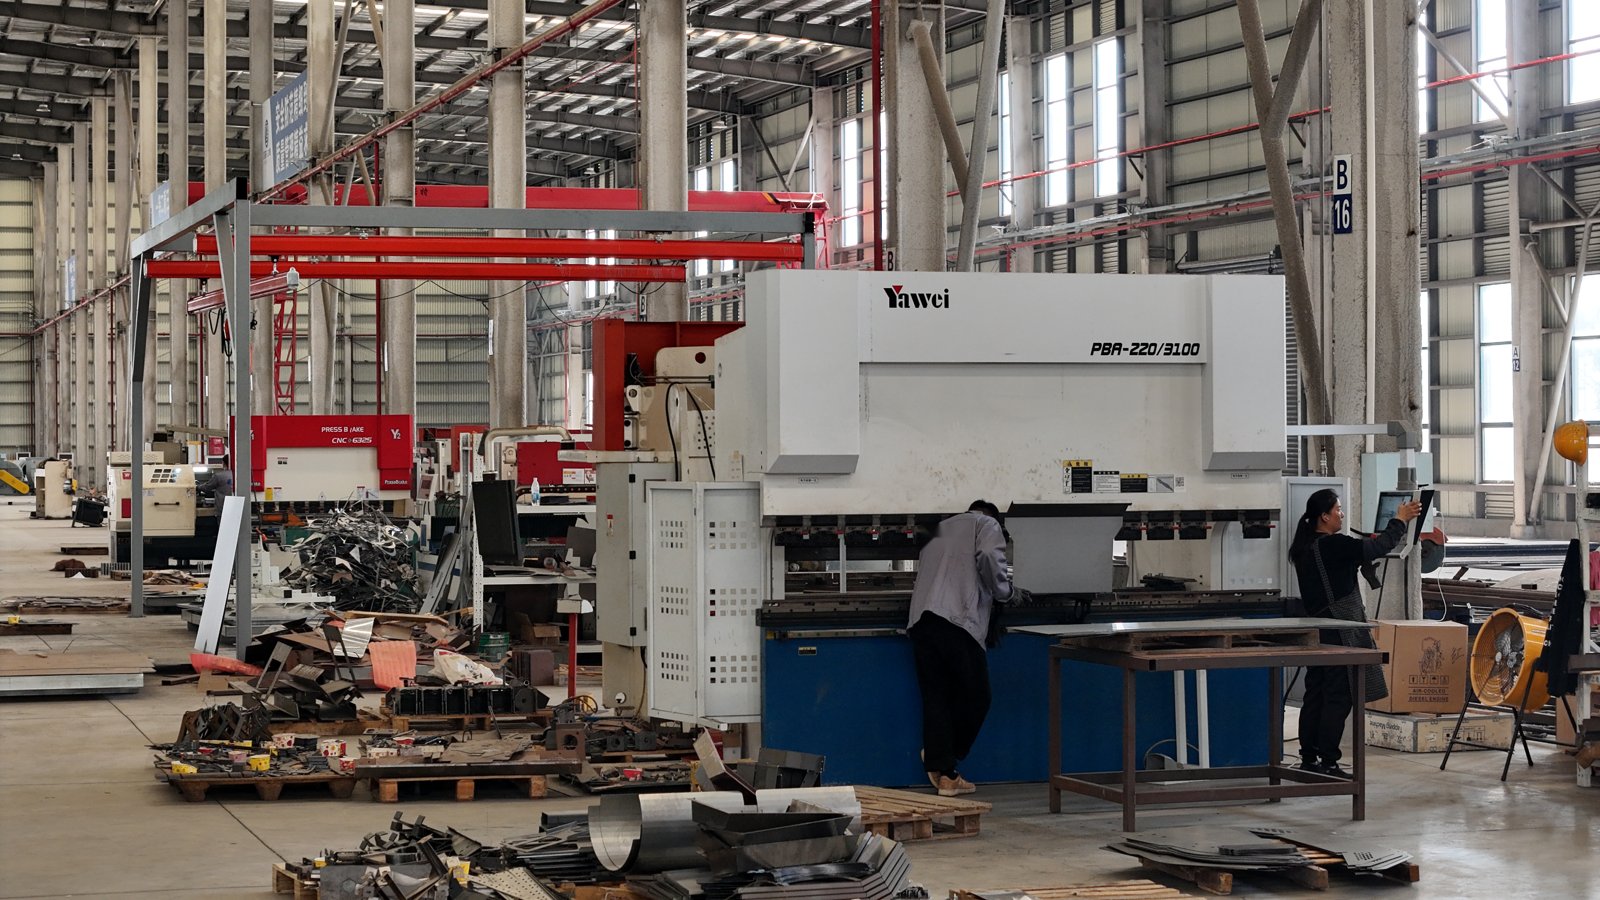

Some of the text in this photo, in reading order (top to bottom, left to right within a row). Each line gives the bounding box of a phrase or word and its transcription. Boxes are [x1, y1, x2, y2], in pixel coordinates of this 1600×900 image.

[1336, 159, 1348, 190] B
[1334, 198, 1350, 229] 16
[888, 251, 893, 271] B
[883, 285, 950, 309] Yawei
[1090, 342, 1201, 356] PBA-220/3100
[1513, 347, 1518, 357] A
[1512, 360, 1520, 370] 12
